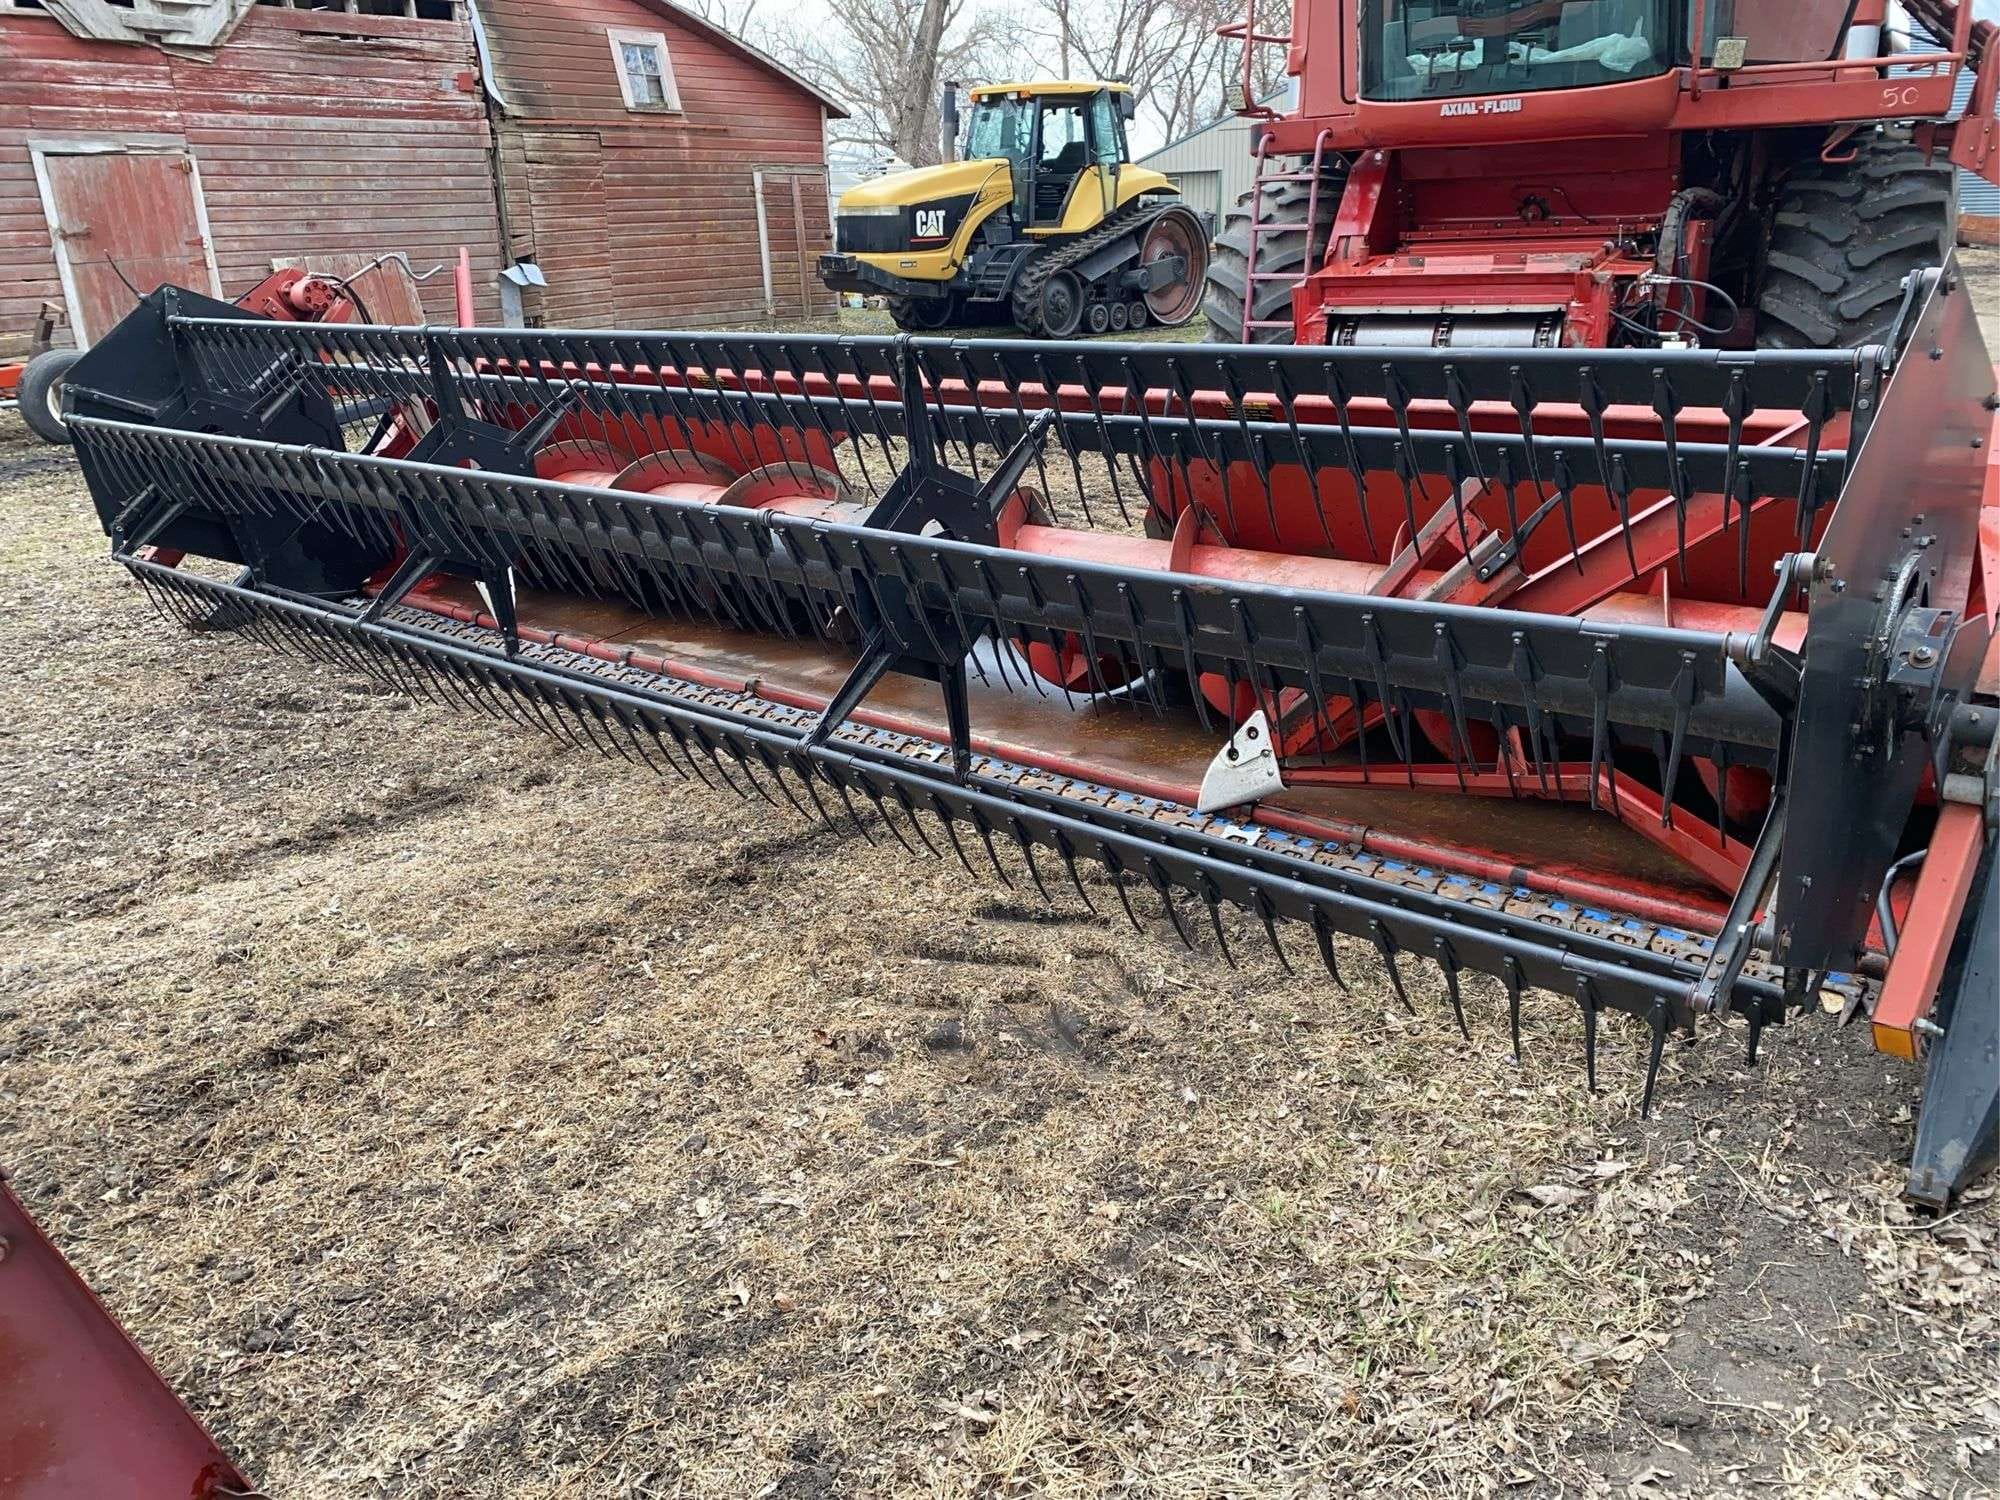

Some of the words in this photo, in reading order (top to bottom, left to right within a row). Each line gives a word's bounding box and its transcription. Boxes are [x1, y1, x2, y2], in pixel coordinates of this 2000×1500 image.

[1880, 86, 1920, 107] 50
[1440, 99, 1522, 117] AXIAL-FLOW
[915, 209, 946, 237] CAT
